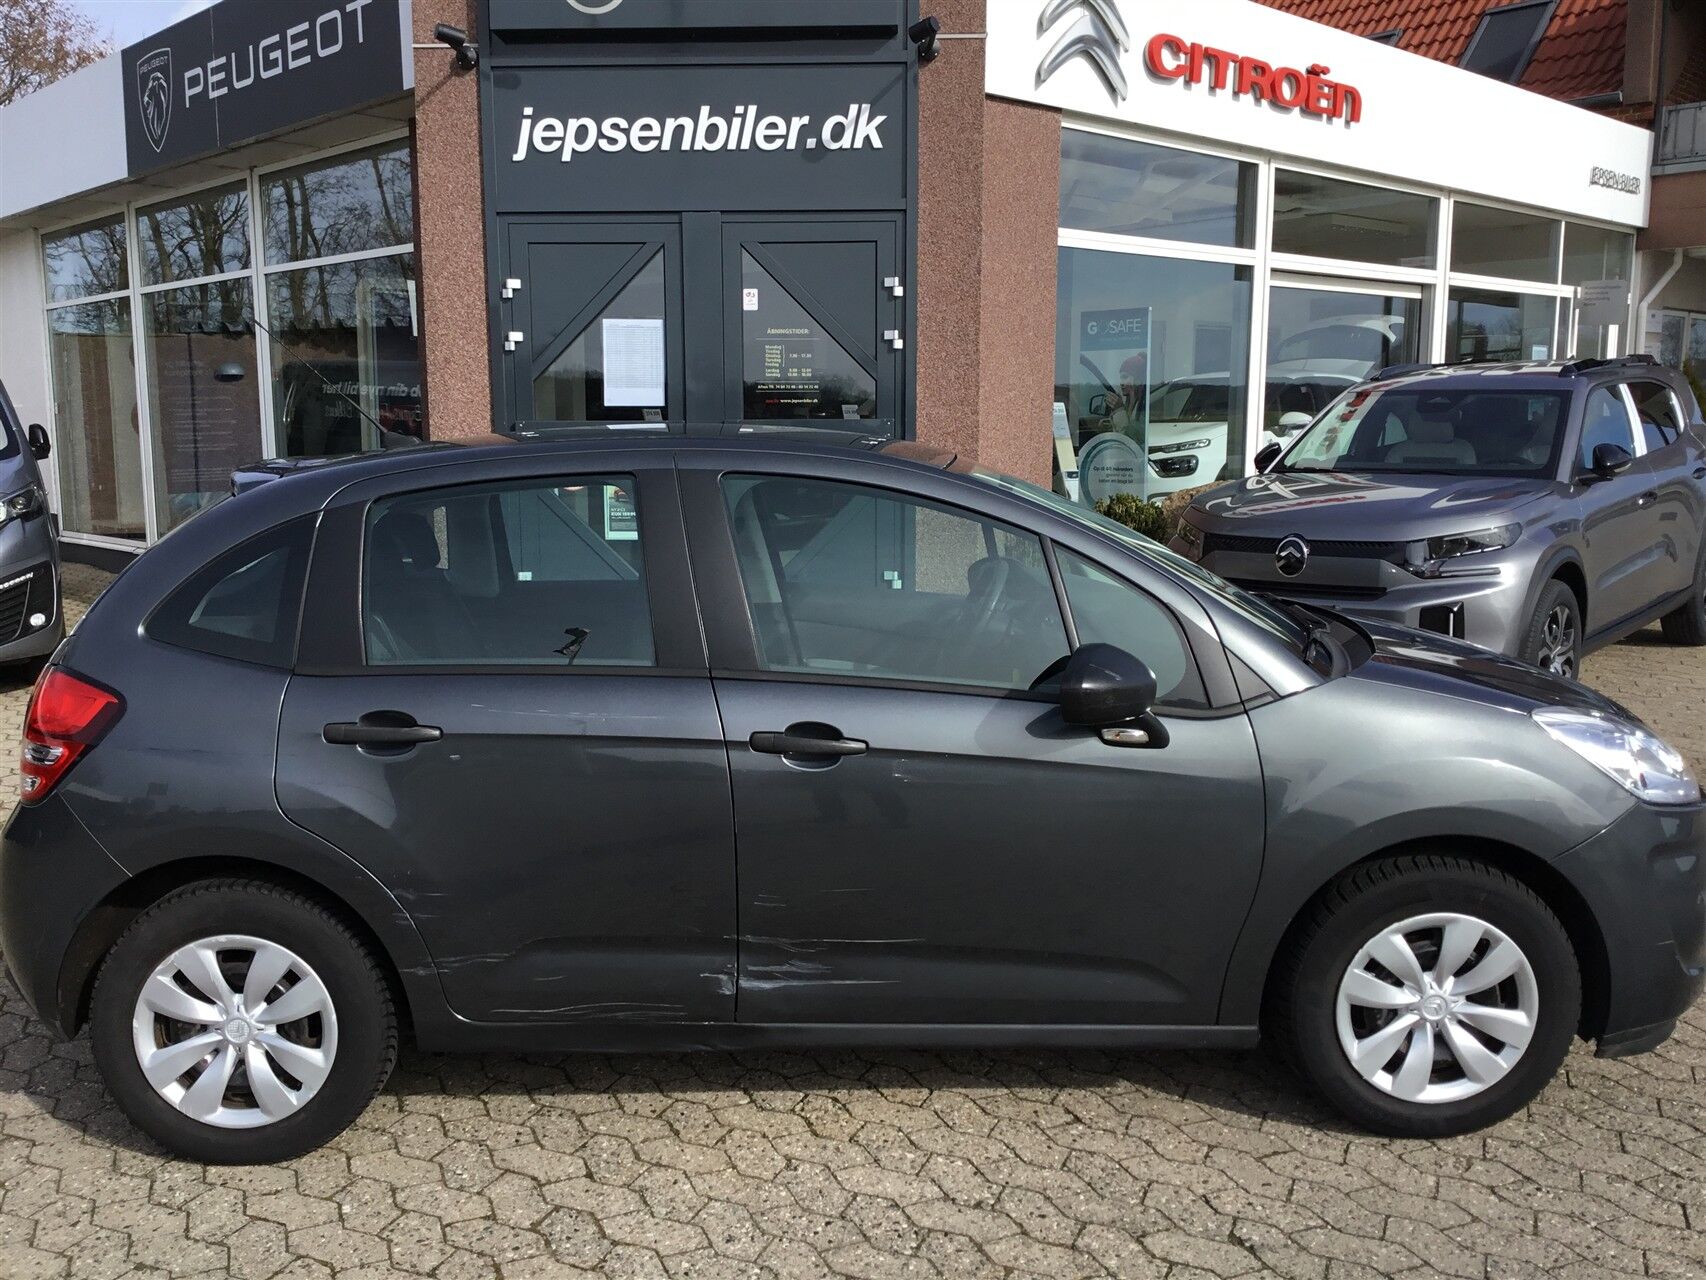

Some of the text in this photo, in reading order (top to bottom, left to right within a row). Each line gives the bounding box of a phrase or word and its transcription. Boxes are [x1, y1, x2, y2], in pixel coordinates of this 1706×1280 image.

[140, 56, 168, 74] PEUGEOT
[184, 0, 373, 108] PEUGEOT
[512, 103, 887, 162] jepsenbiler.dk
[1108, 318, 1142, 334] SAFE
